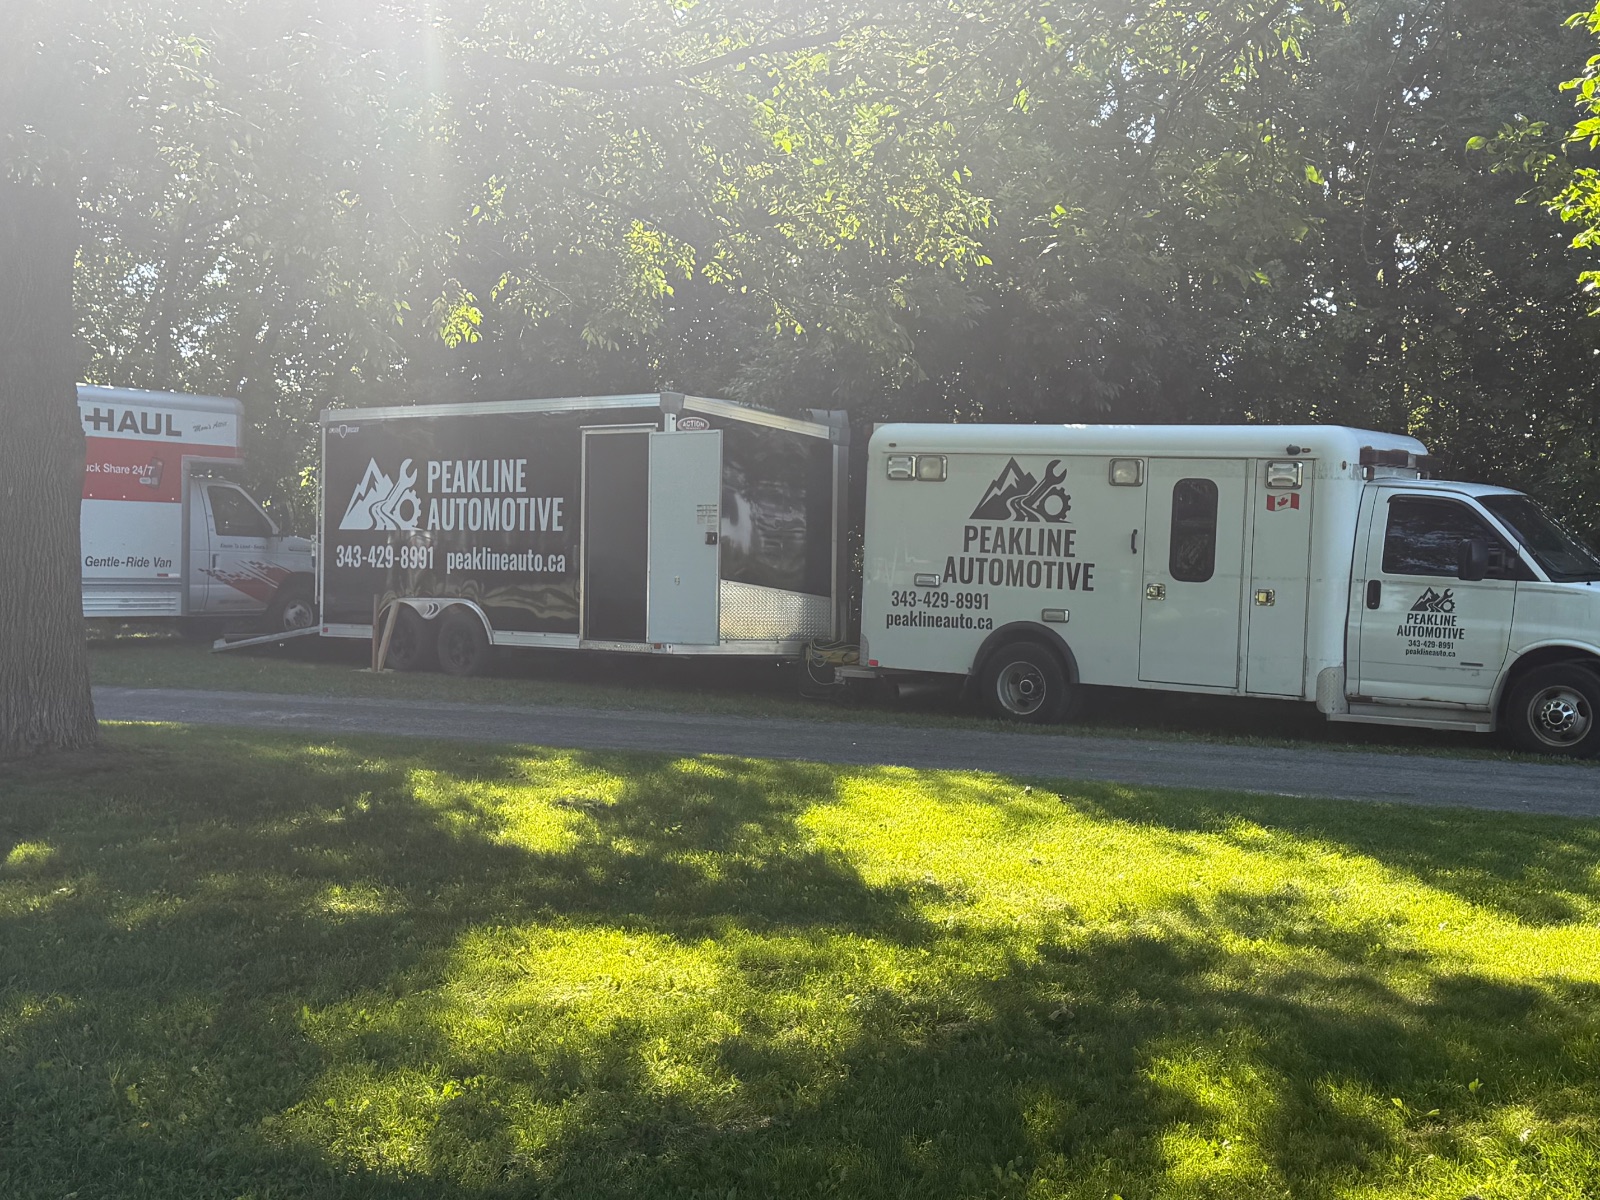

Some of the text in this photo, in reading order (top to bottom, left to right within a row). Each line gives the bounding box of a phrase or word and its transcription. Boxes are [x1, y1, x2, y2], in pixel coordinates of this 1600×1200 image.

[78, 406, 183, 437] -HAUL
[683, 420, 704, 428] ACTION
[103, 463, 130, 474] Share
[132, 464, 154, 477] 24/7
[427, 458, 527, 493] PEAKLINE
[427, 497, 564, 532] AUTOMOTIVE
[963, 525, 1077, 558] PEAKLINE
[85, 555, 172, 568] Gentle-Ride Van
[336, 545, 566, 574] 343-429-8991 peaklineauto.ca
[942, 556, 1095, 592] AUTOMOTIVE
[891, 591, 989, 610] 343-429-8991
[886, 611, 993, 631] peaklineauto.ca
[1406, 613, 1457, 627] PEAKLINE
[1397, 625, 1465, 640] AUTOMOTIVE
[1408, 640, 1454, 649] 343-429-8991
